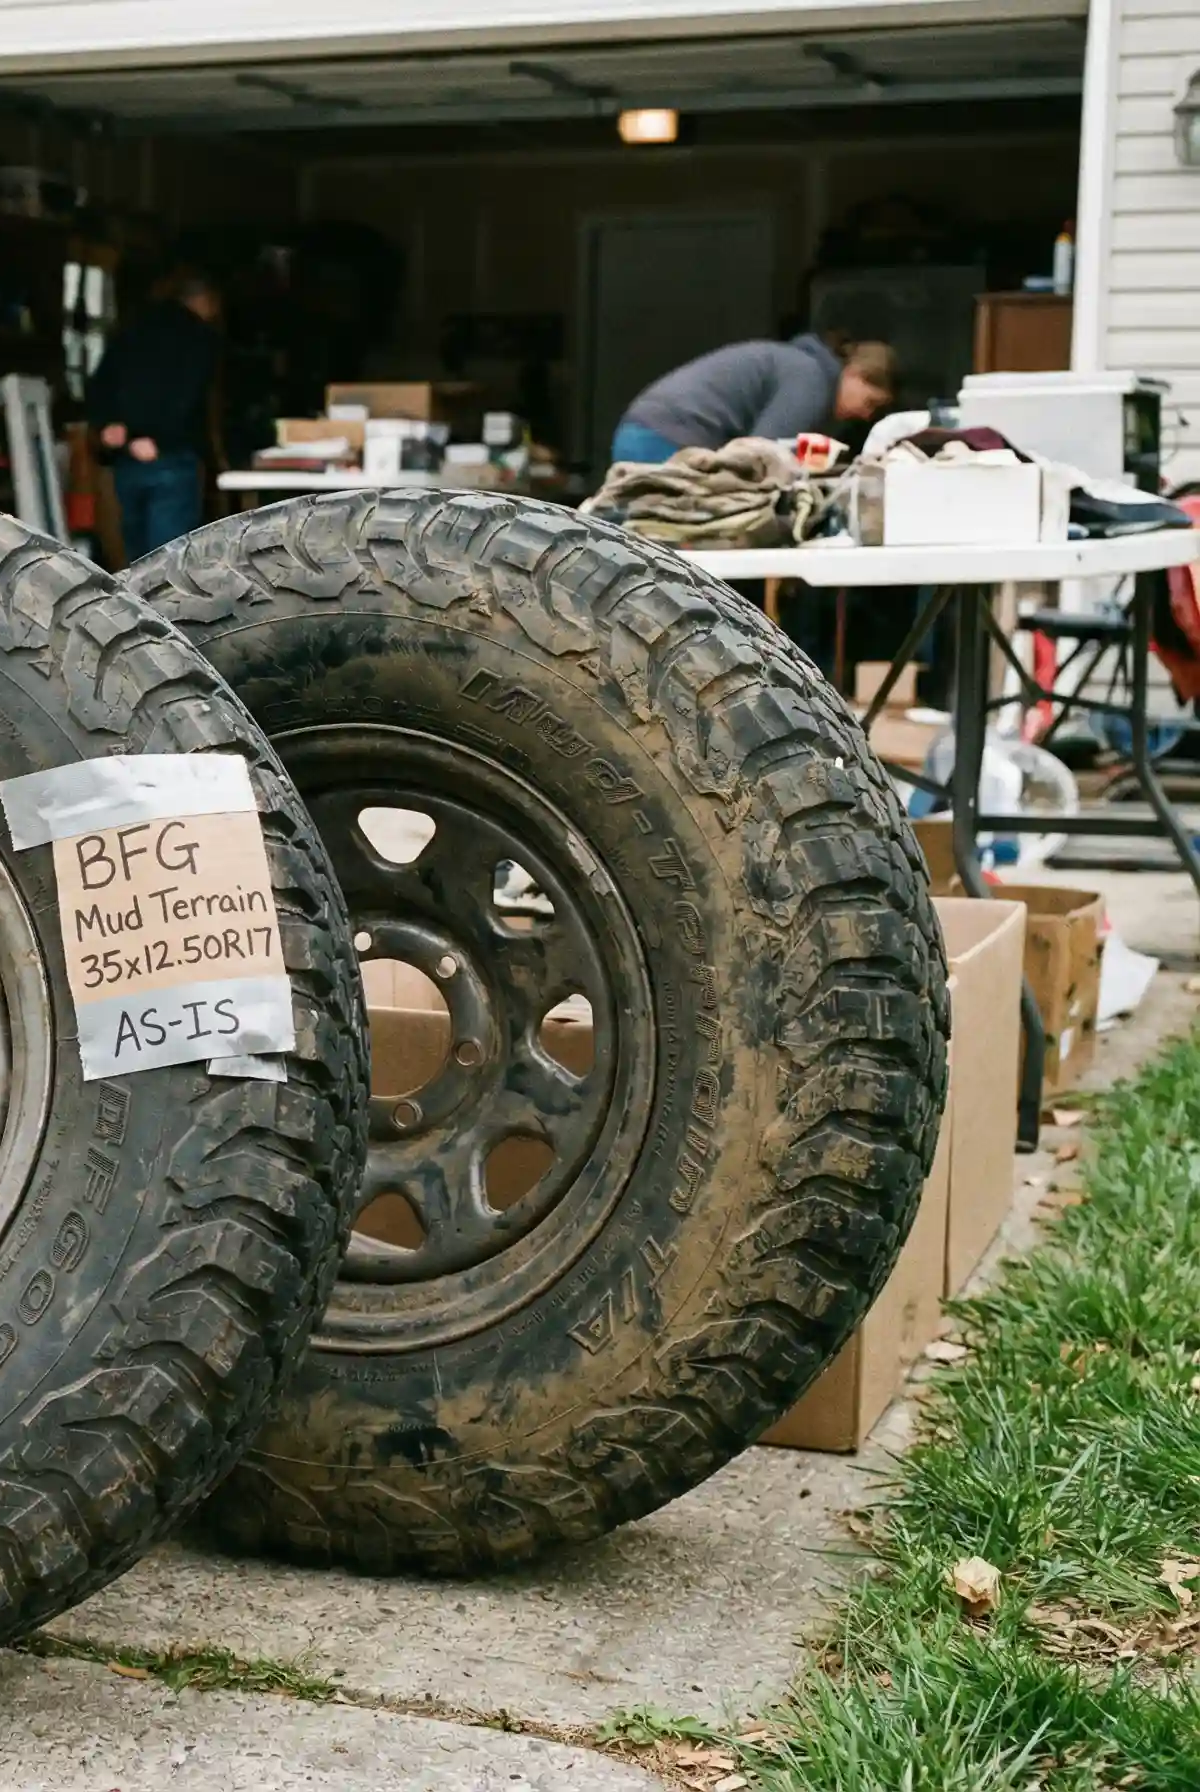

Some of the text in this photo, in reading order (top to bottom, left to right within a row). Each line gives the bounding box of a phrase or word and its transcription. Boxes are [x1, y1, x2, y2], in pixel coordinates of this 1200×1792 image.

[75, 820, 200, 891] BFG
[74, 884, 268, 943] Mud Terrain
[80, 926, 273, 988] 35x12.50R17
[114, 998, 240, 1058] AS-IS
